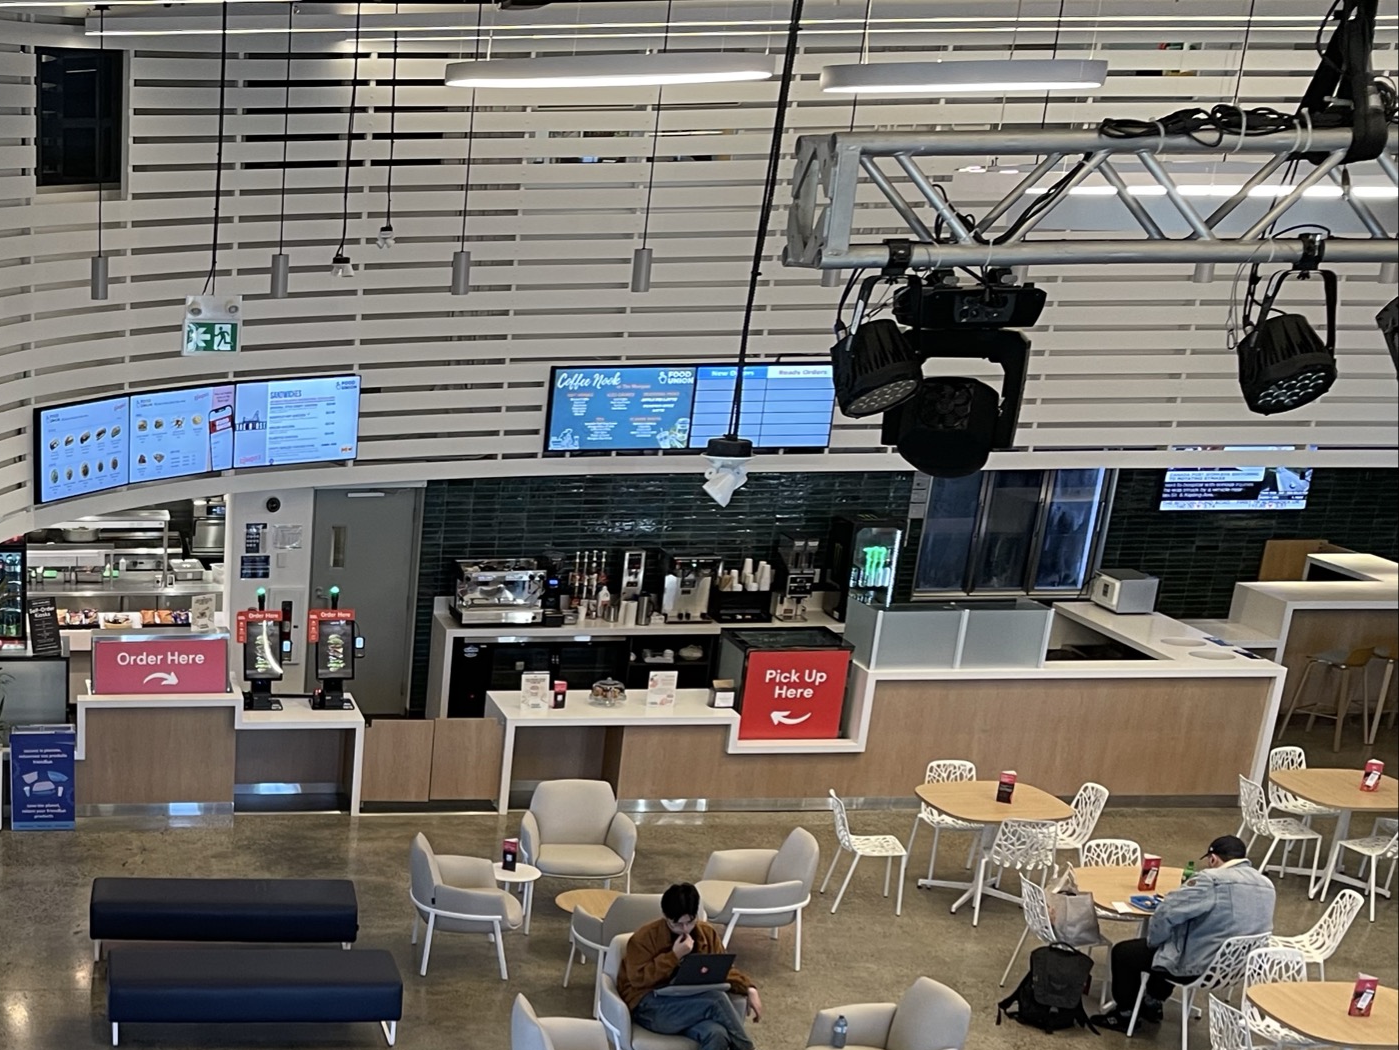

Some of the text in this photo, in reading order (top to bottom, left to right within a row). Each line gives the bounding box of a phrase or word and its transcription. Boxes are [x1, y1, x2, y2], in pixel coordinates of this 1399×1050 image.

[667, 370, 692, 378] FOOD
[557, 372, 622, 390] Coffee Nook
[667, 377, 695, 385] UNION
[29, 606, 55, 614] Self-Order
[117, 651, 205, 665] Order Here
[765, 669, 827, 686] Pick Up
[774, 685, 814, 698] Here
